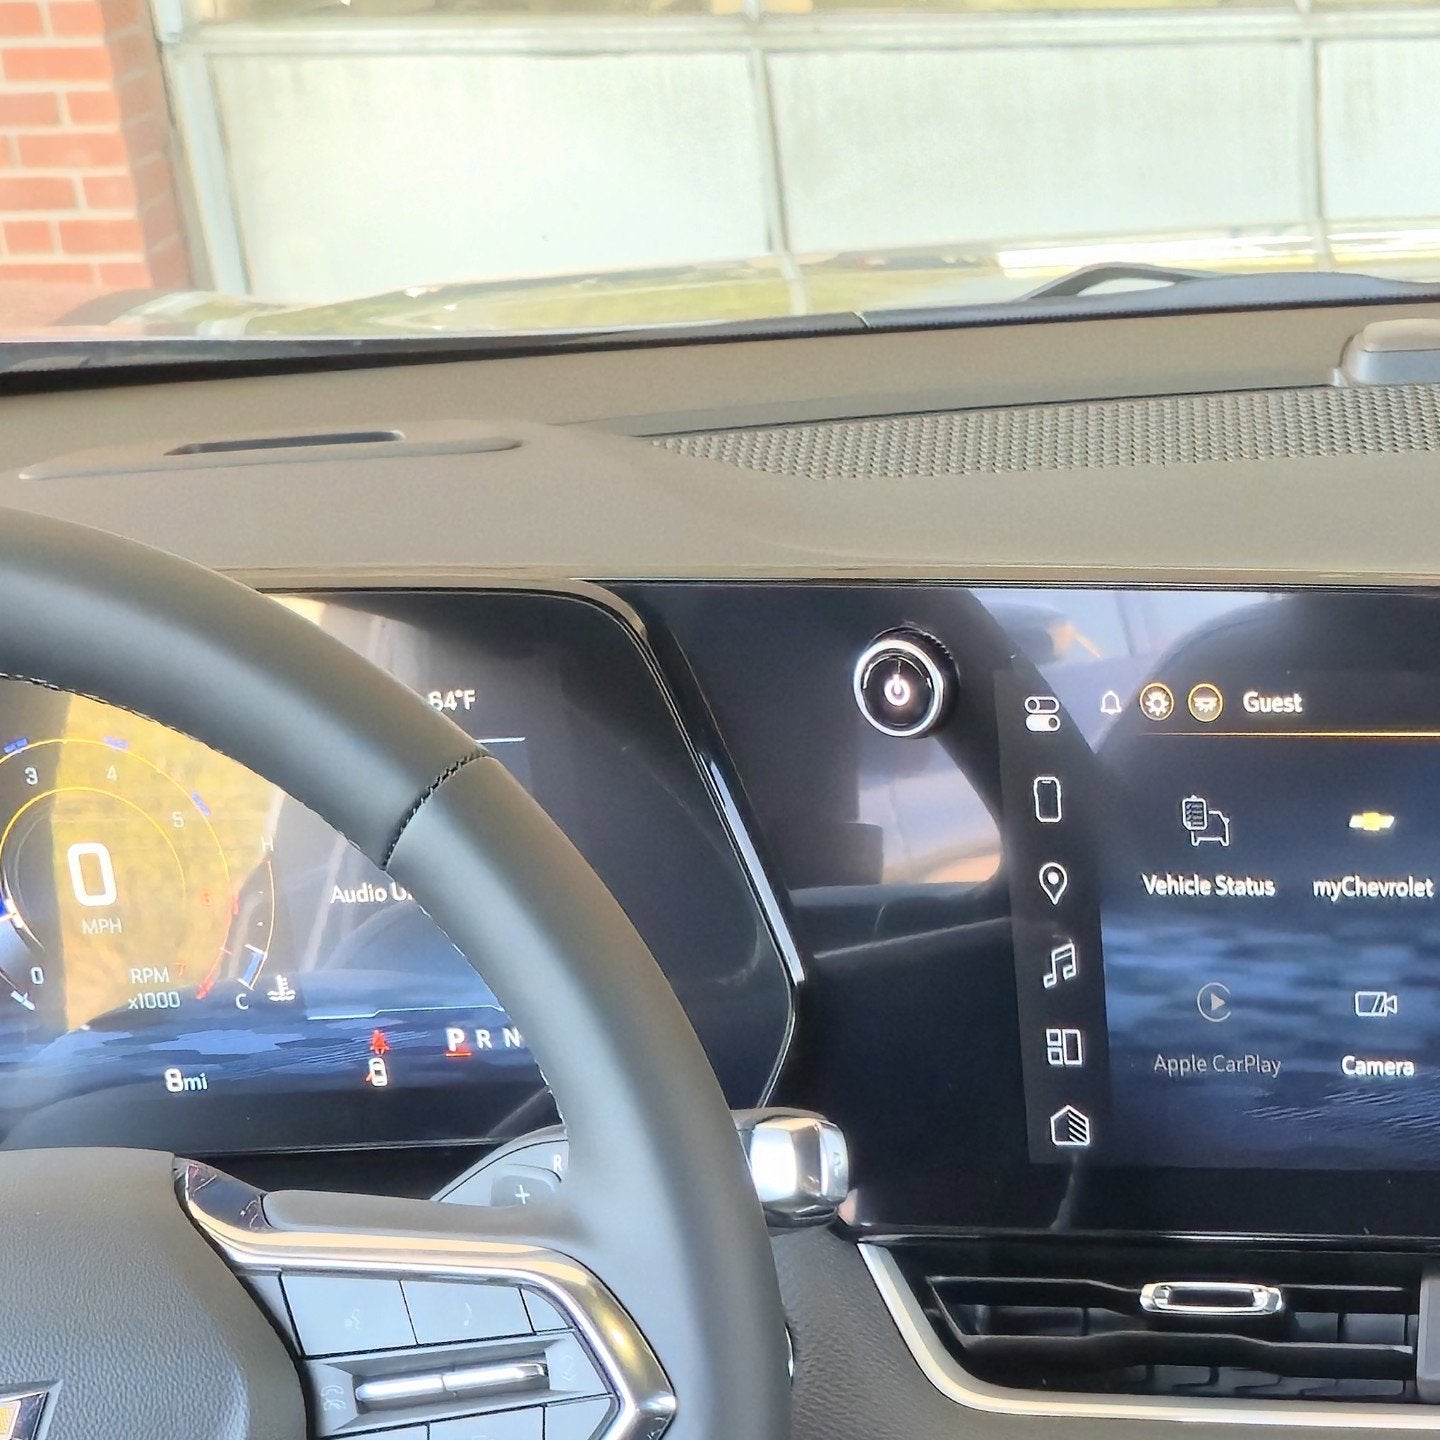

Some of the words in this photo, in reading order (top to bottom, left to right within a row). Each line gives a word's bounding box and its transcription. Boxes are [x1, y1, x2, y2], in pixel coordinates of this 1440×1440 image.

[1243, 691, 1302, 714] Guest
[25, 767, 38, 785] 3
[67, 842, 117, 906] 0
[330, 883, 387, 903] Audio
[1141, 873, 1212, 897] Vehicle
[1216, 875, 1275, 898] Status
[1313, 875, 1434, 902] myChevrolet
[82, 918, 122, 935] MPH
[31, 967, 44, 984] 0
[131, 968, 169, 983] RPM
[128, 992, 180, 1009] x1000
[236, 995, 248, 1009] C
[446, 1029, 464, 1050] P
[476, 1028, 492, 1048] R
[503, 1027, 520, 1046] N
[1154, 1054, 1207, 1075] Apple
[1213, 1054, 1281, 1078] CarPlay
[1342, 1055, 1414, 1076] Camera
